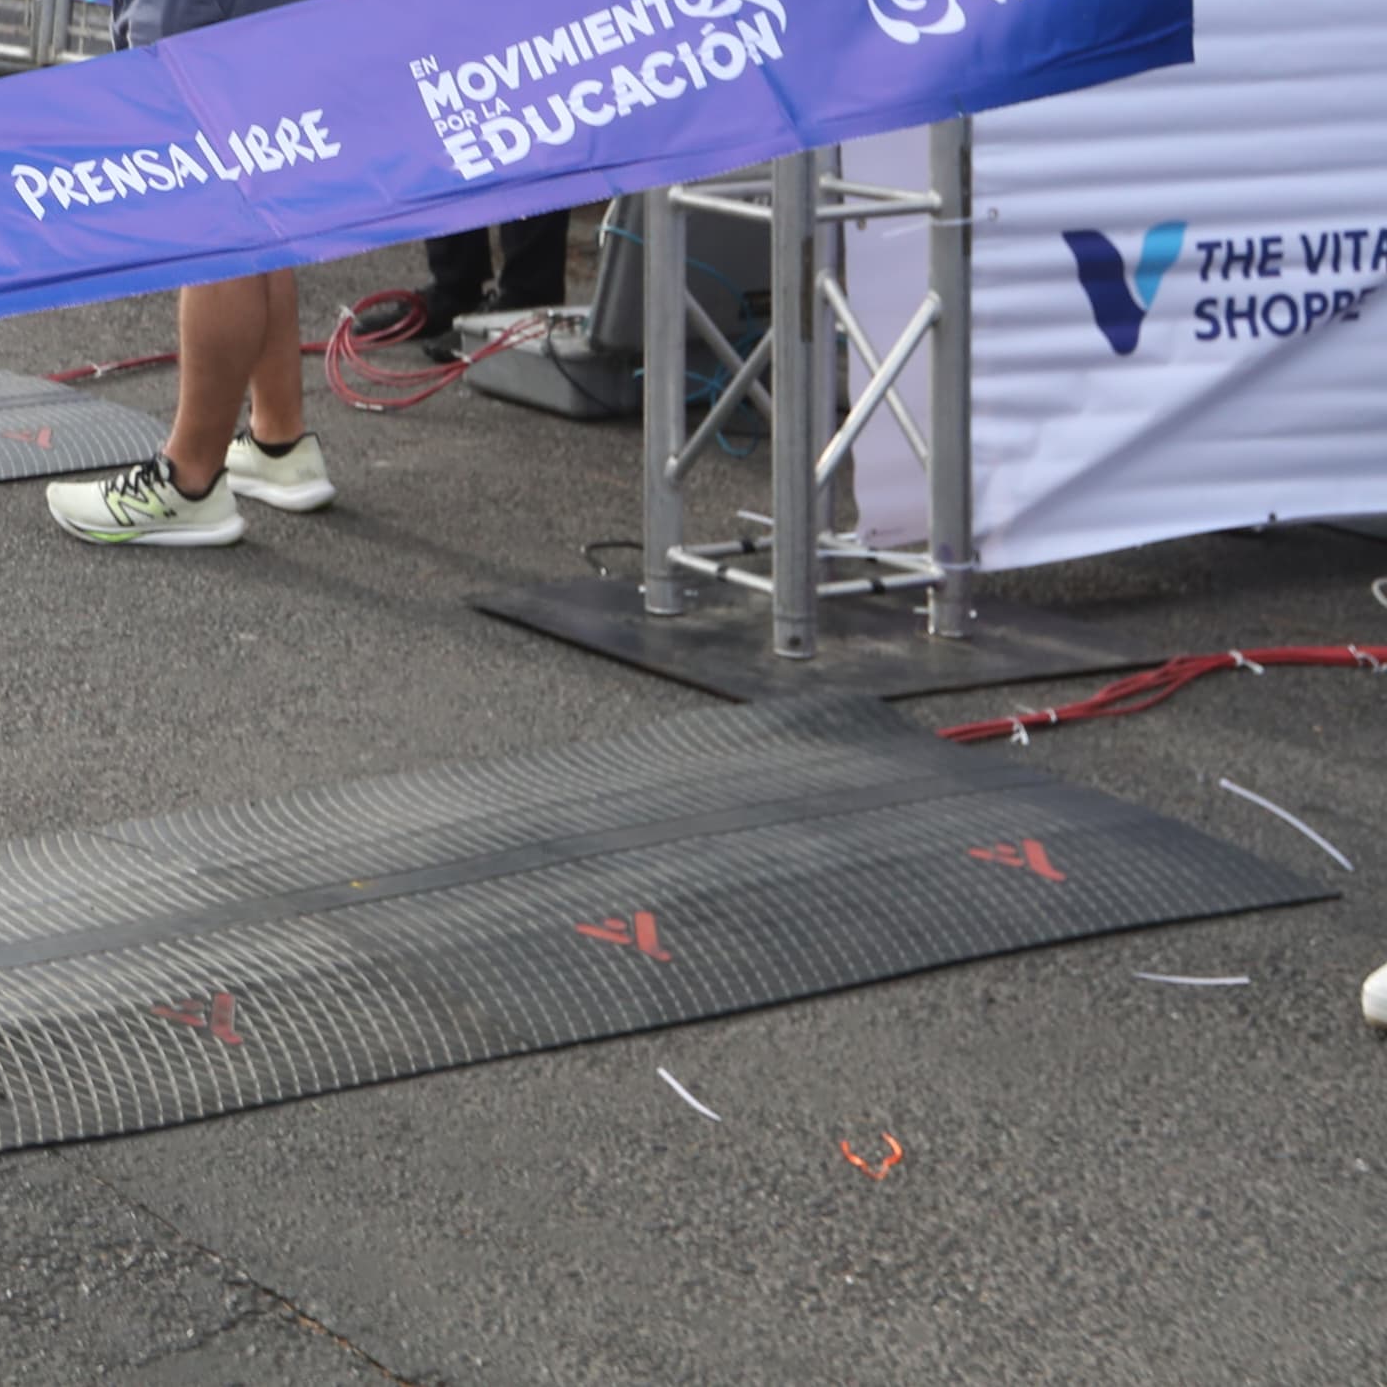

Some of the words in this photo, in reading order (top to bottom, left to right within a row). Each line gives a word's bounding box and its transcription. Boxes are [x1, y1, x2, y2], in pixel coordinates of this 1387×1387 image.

[409, 54, 439, 80] EN
[433, 108, 479, 137] POR
[479, 97, 511, 119] LA
[442, 11, 784, 181] EDUCACIÓN
[1196, 236, 1283, 282] THE
